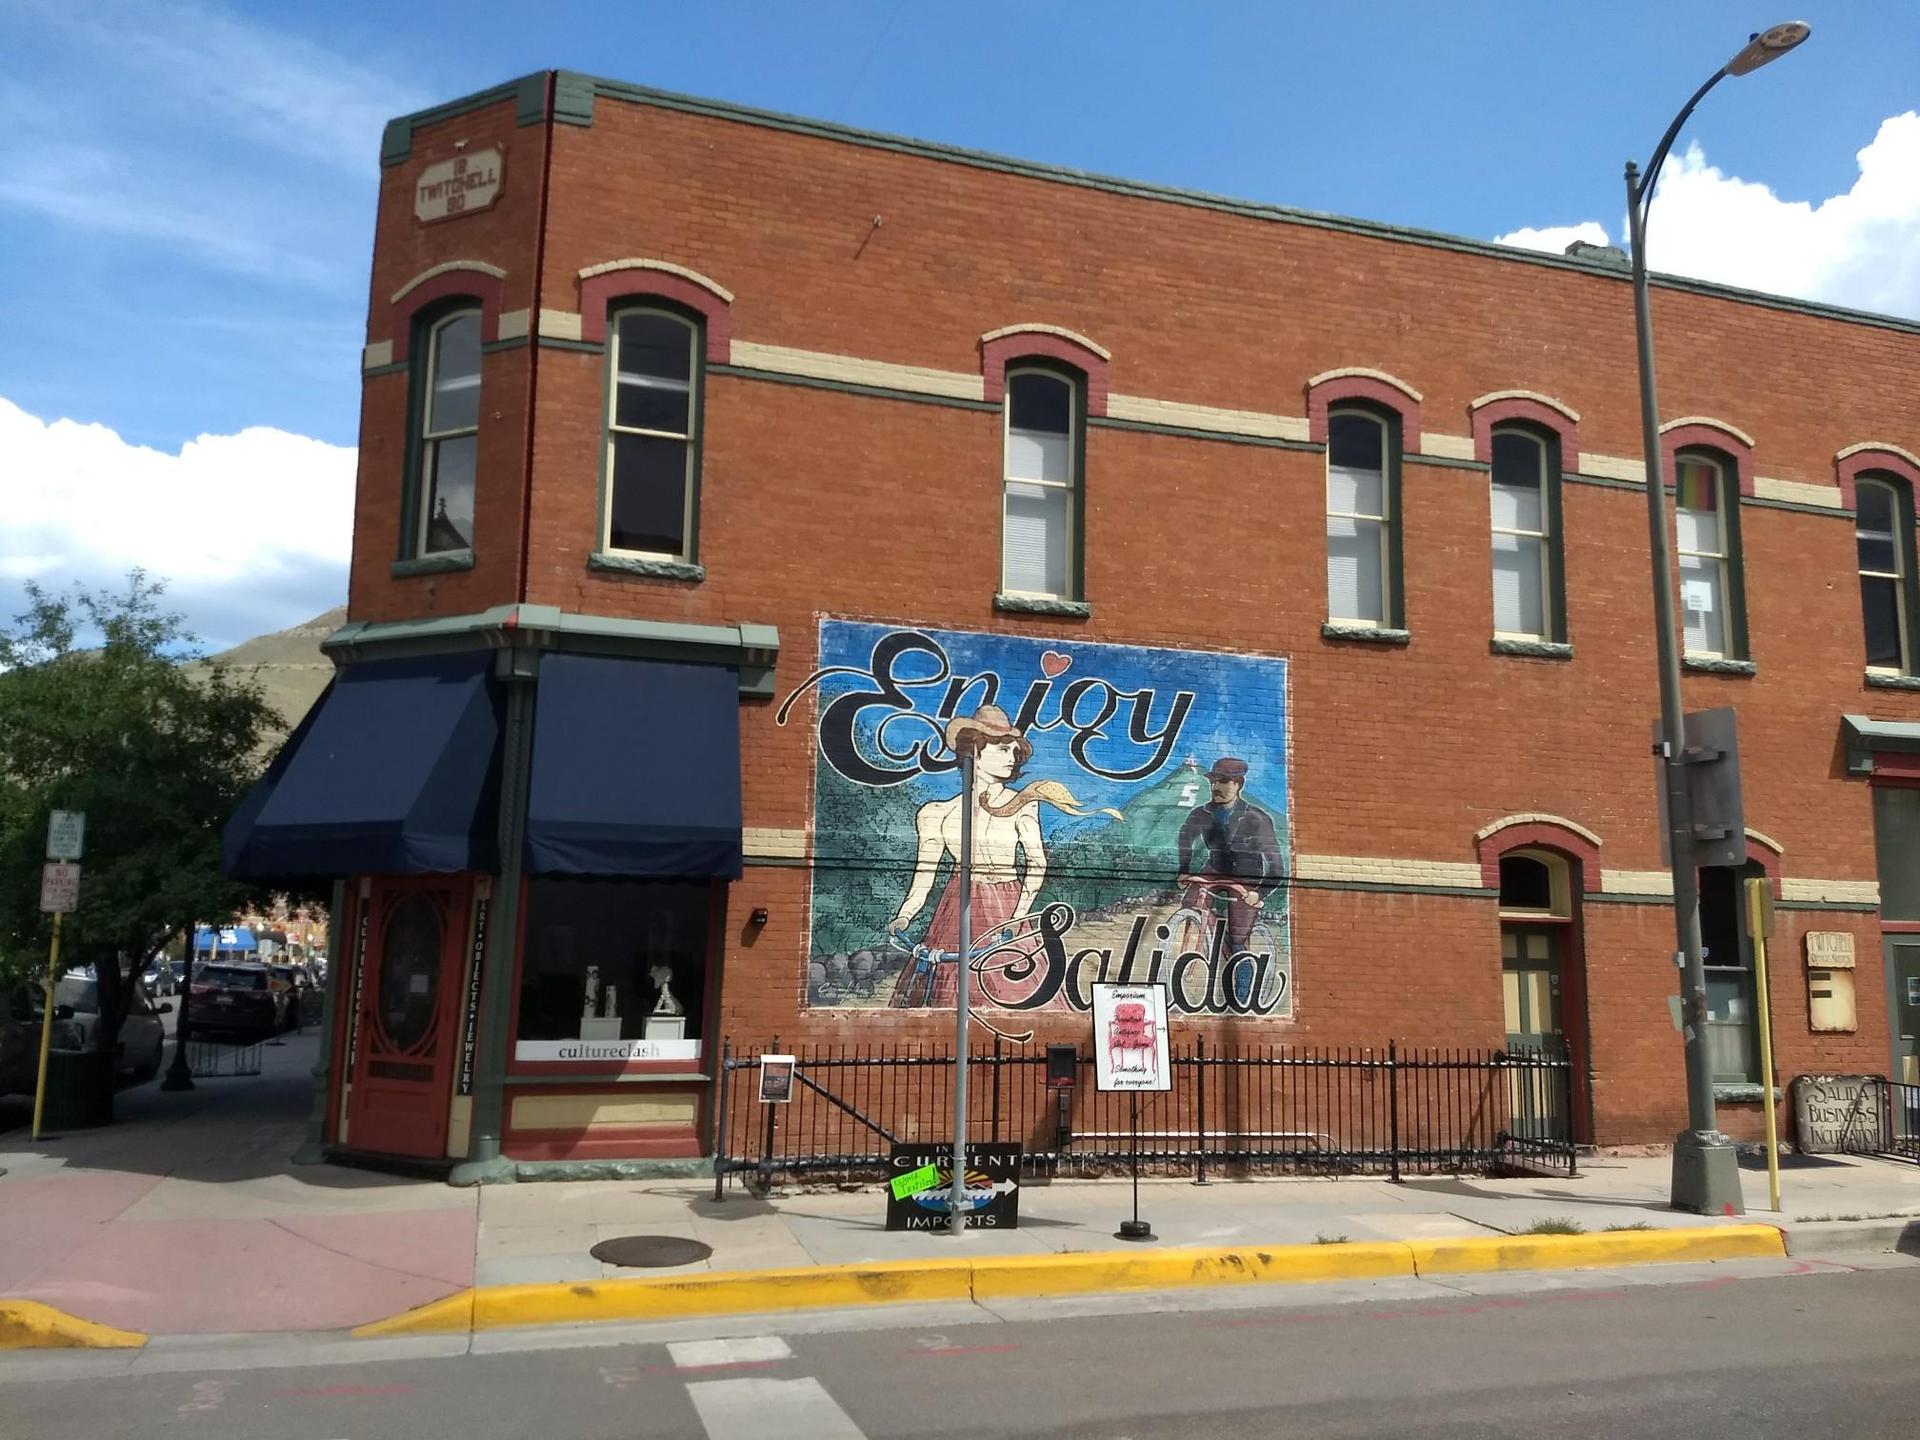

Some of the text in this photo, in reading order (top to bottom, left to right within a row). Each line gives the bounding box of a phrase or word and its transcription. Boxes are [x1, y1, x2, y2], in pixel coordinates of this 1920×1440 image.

[776, 631, 1195, 787] Enjoy
[968, 902, 1286, 1041] Salida
[1111, 989, 1146, 1000] Emporium
[558, 1044, 660, 1059] cultureclash
[1114, 1064, 1147, 1076] Something
[1113, 1078, 1124, 1088] for
[1805, 1084, 1870, 1105] SALIDA
[893, 1154, 1018, 1168] CURENT
[906, 1214, 997, 1229] IMPORTS
